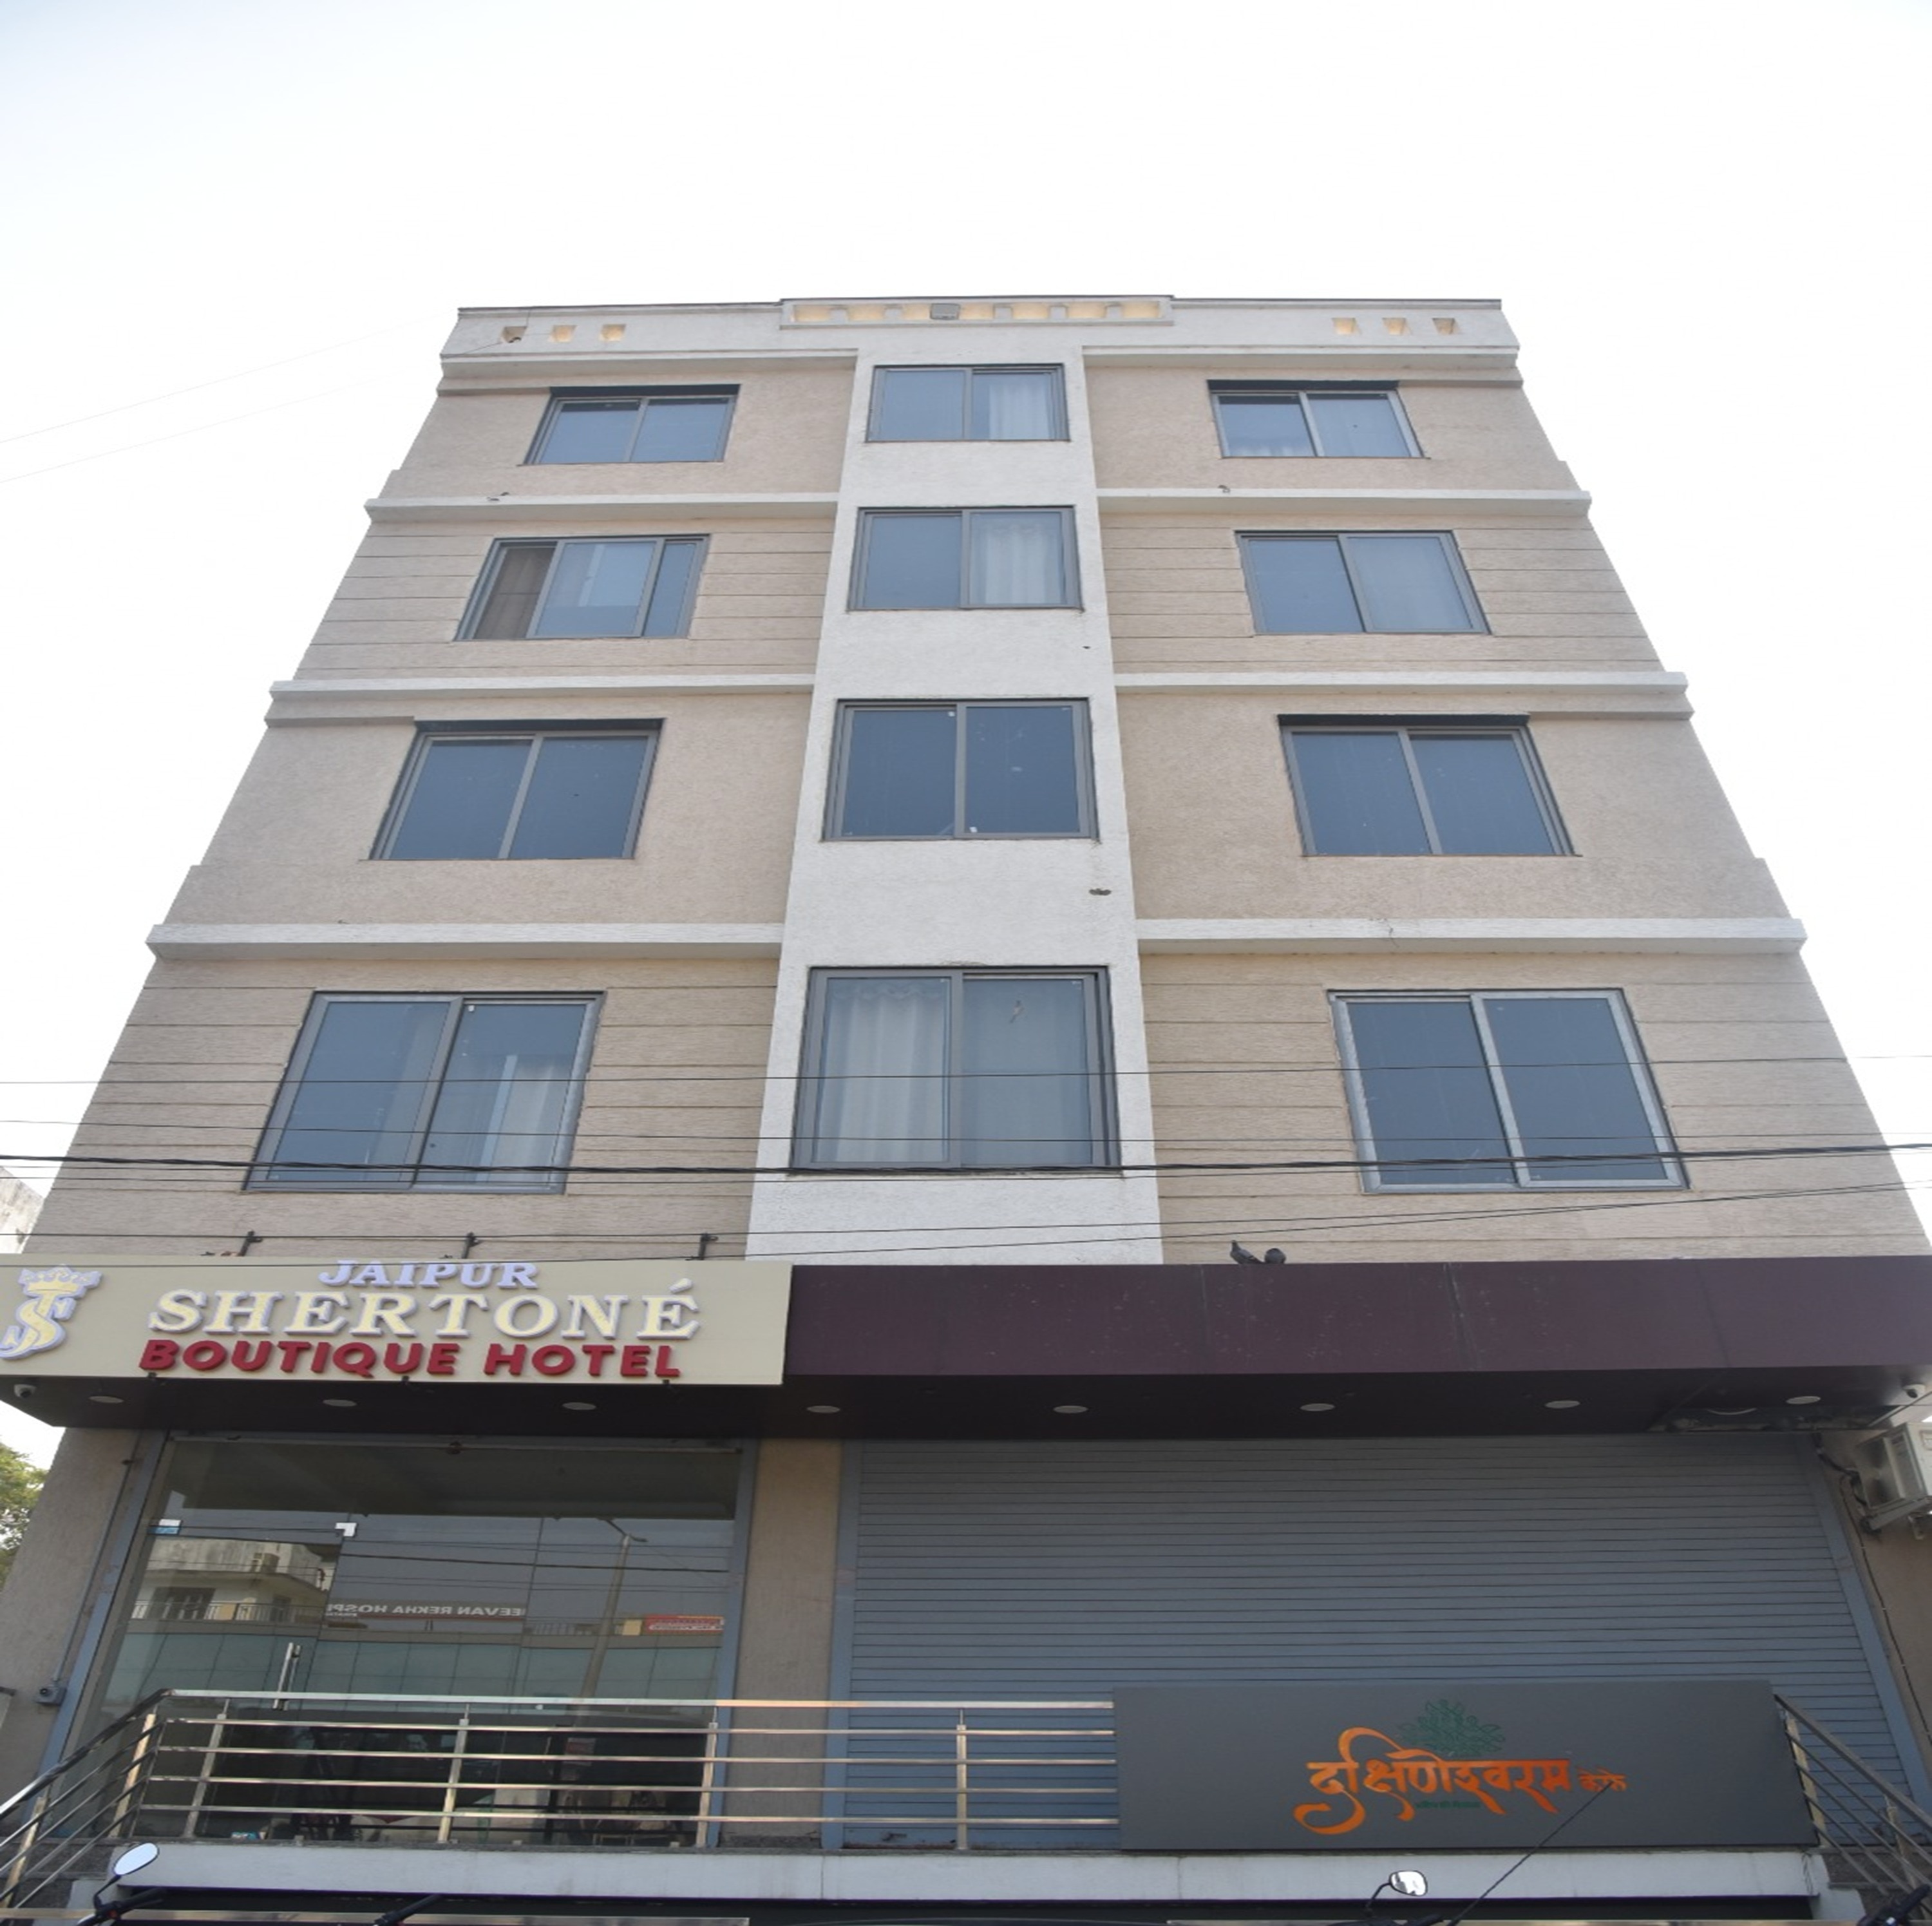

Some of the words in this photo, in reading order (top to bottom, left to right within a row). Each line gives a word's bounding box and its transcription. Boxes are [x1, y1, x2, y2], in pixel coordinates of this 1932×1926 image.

[318, 1260, 540, 1288] JAIPUR
[148, 1278, 700, 1340] SHERTONÉ
[139, 1339, 460, 1377] BOUTIQUE
[483, 1343, 680, 1377] HOTEL
